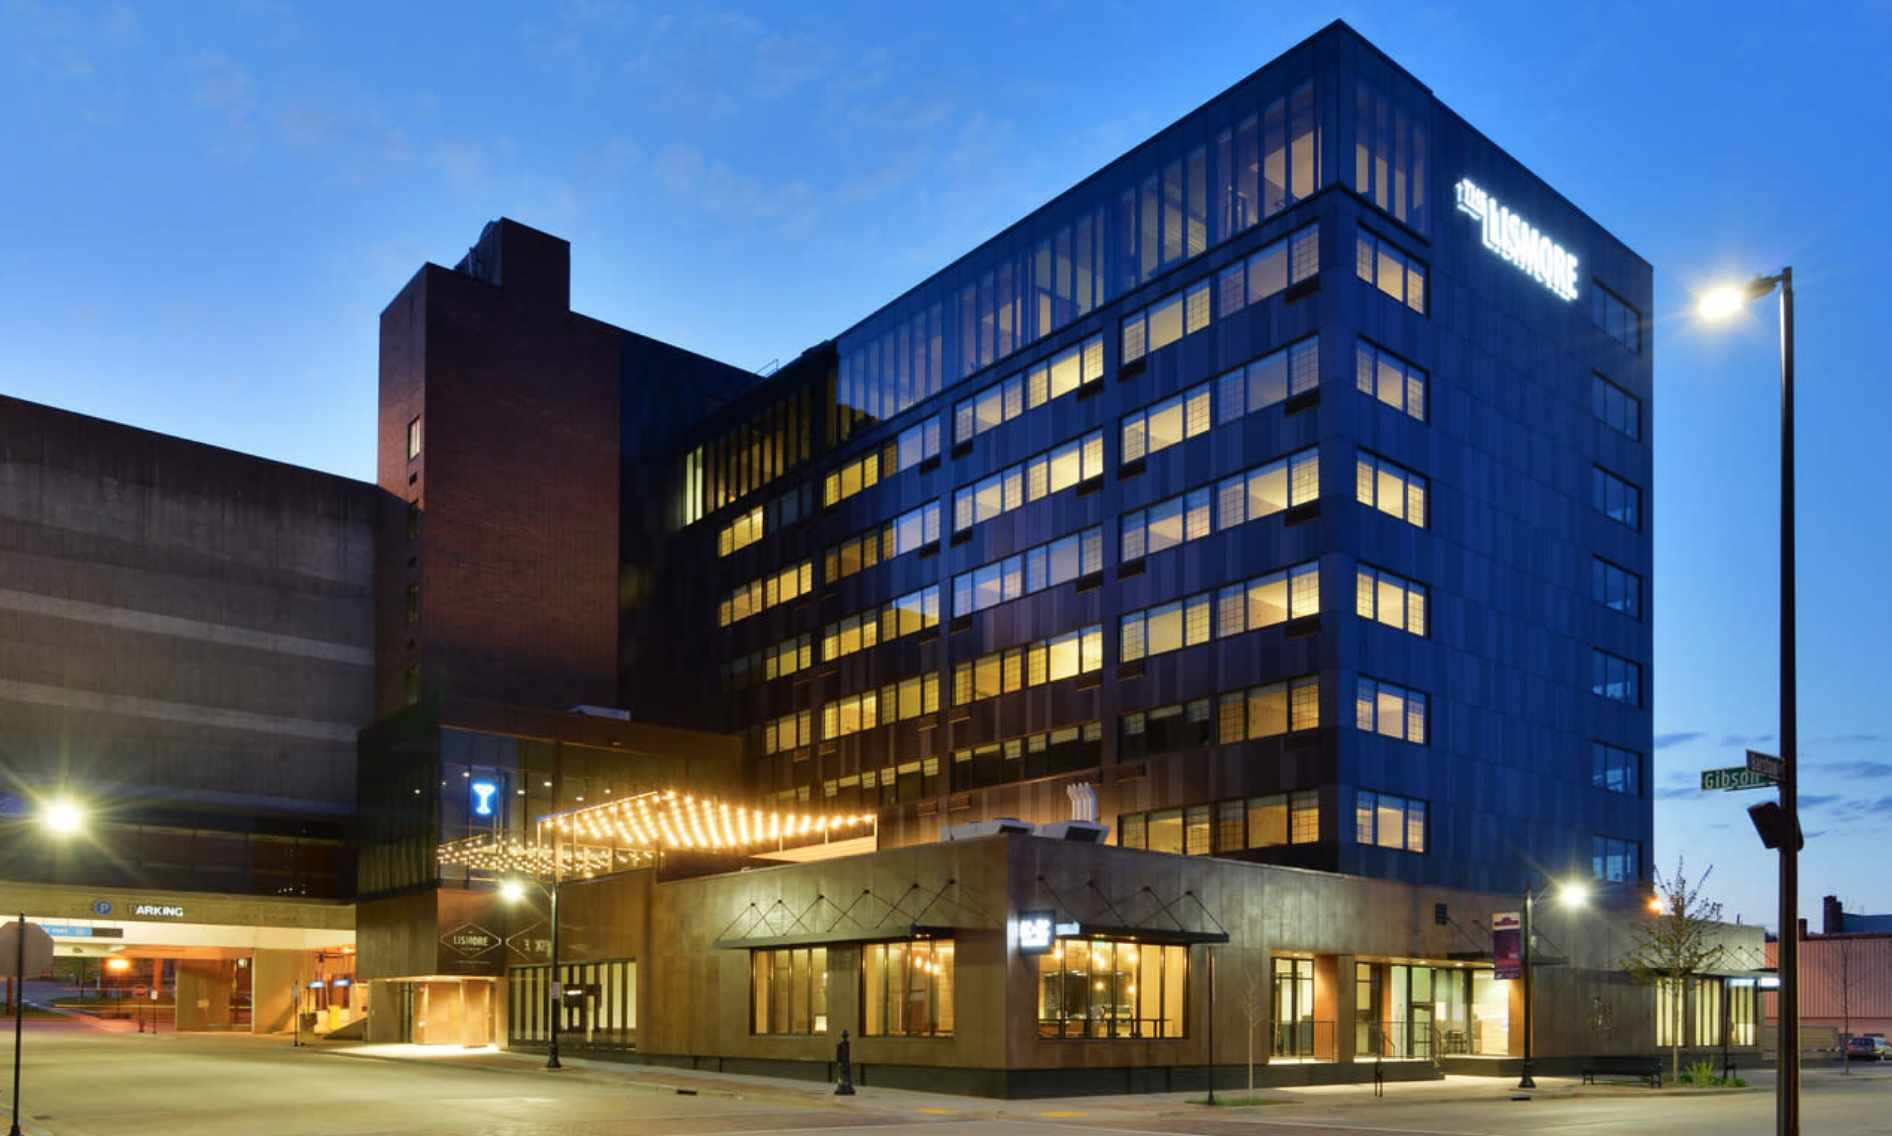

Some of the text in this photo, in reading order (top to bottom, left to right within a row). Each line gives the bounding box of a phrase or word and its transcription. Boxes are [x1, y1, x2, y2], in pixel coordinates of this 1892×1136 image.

[1487, 197, 1578, 301] LISMORE
[1705, 769, 1759, 789] Gibson
[453, 935, 488, 946] LISMORE
